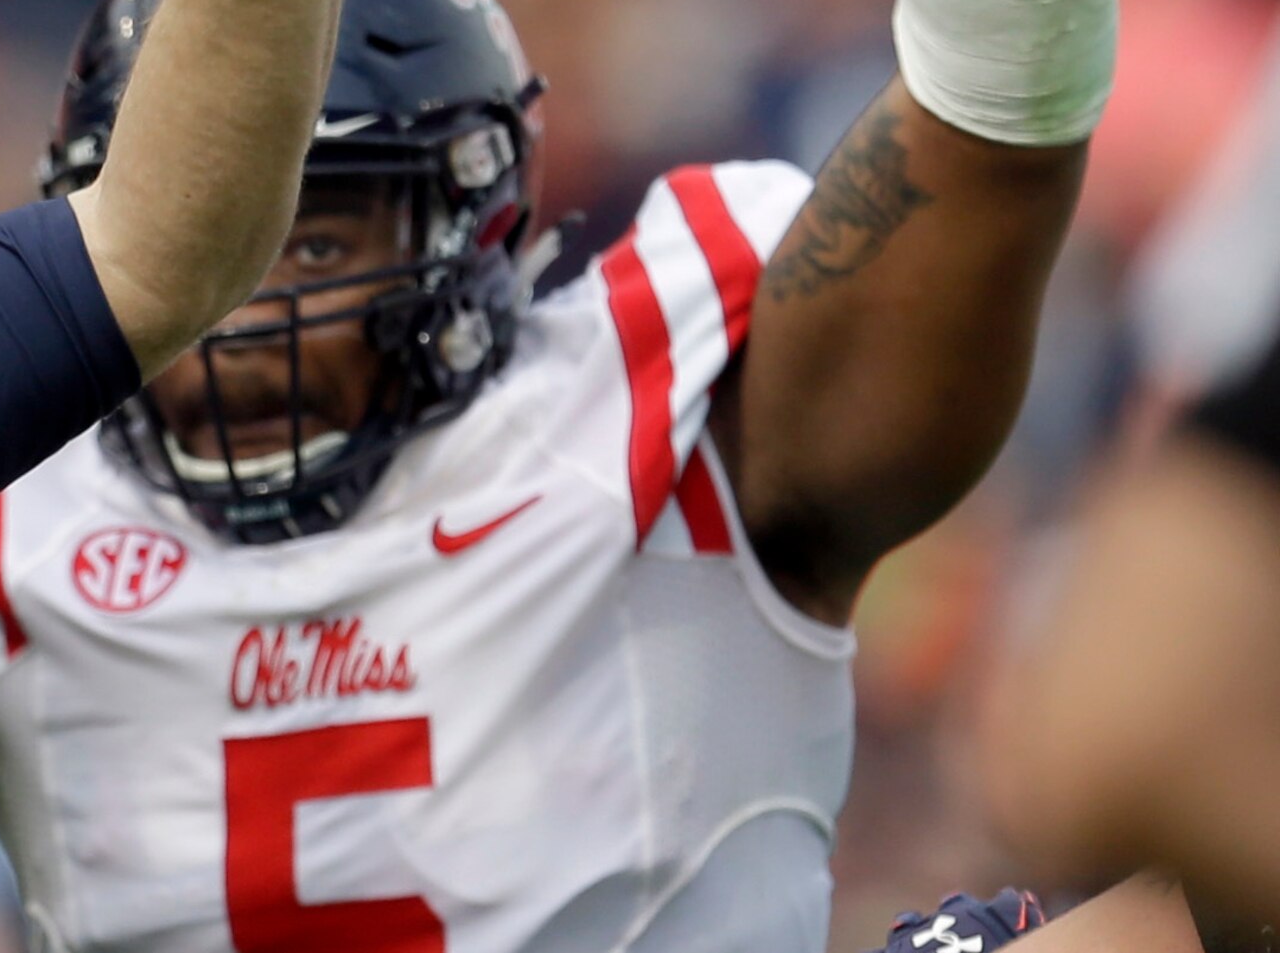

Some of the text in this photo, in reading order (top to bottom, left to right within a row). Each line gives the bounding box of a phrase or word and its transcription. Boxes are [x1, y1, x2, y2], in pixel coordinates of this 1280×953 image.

[74, 530, 184, 610] SEC
[230, 613, 417, 712] Ole Miss
[223, 716, 447, 953] 5
